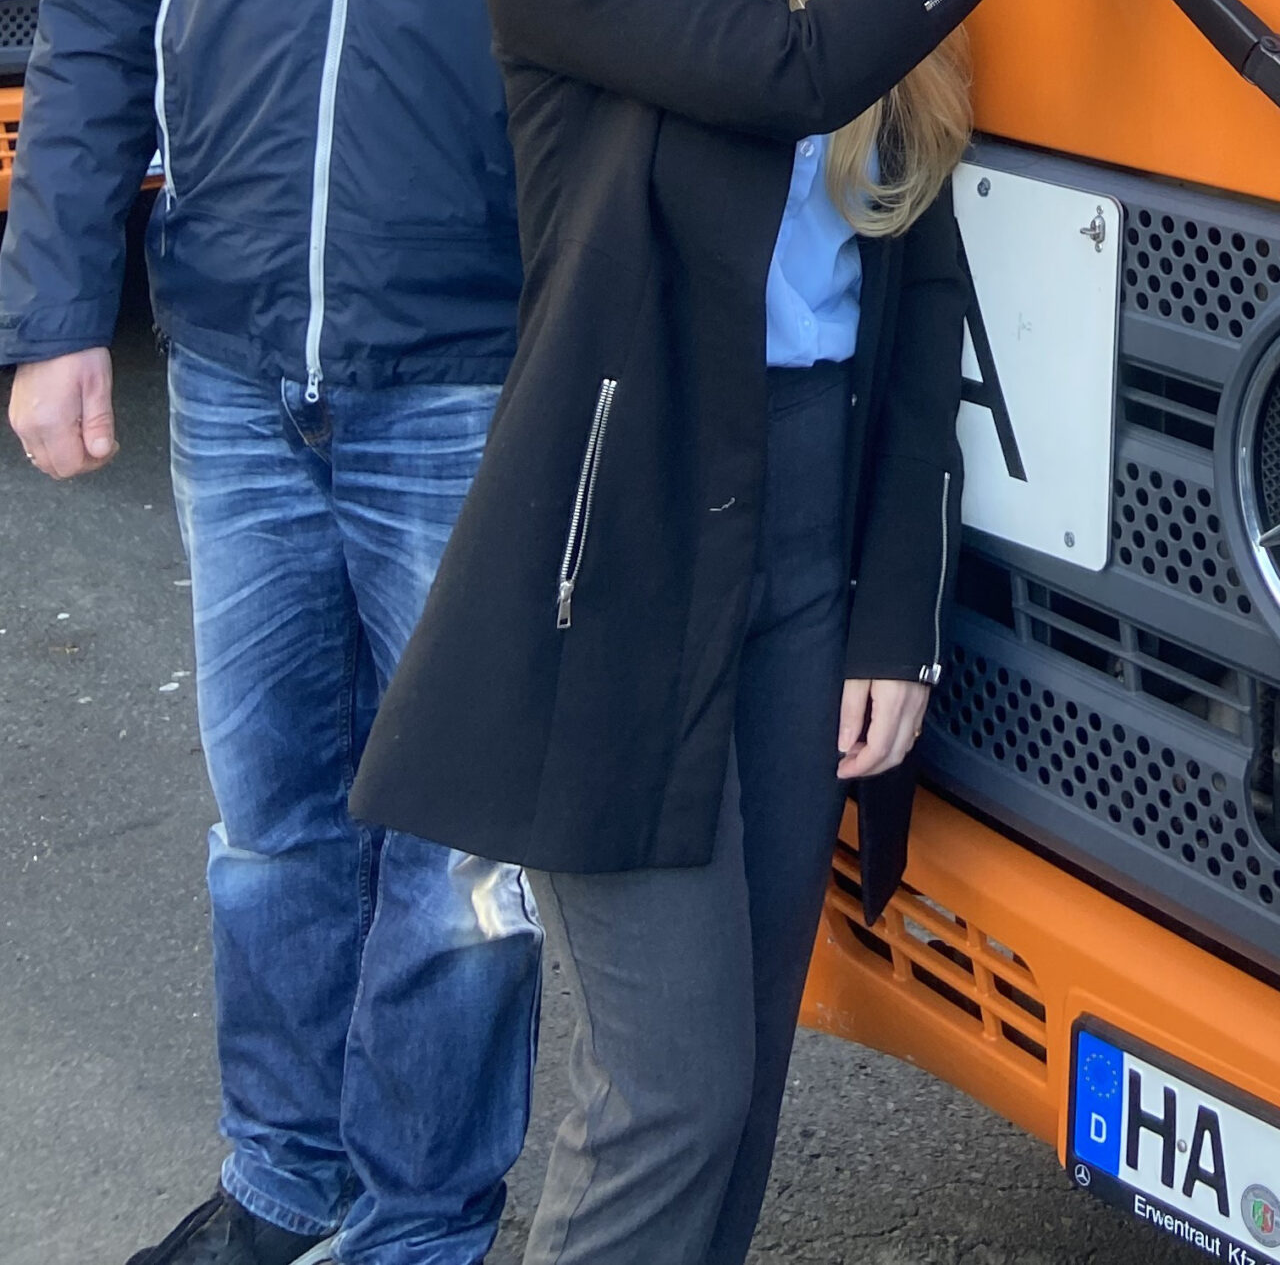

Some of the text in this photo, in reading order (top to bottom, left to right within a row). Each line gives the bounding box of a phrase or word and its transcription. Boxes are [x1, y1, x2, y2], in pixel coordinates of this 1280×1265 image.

[1090, 1111, 1108, 1144] D
[1126, 1067, 1230, 1218] HA
[1134, 1193, 1222, 1262] Erwentraut
